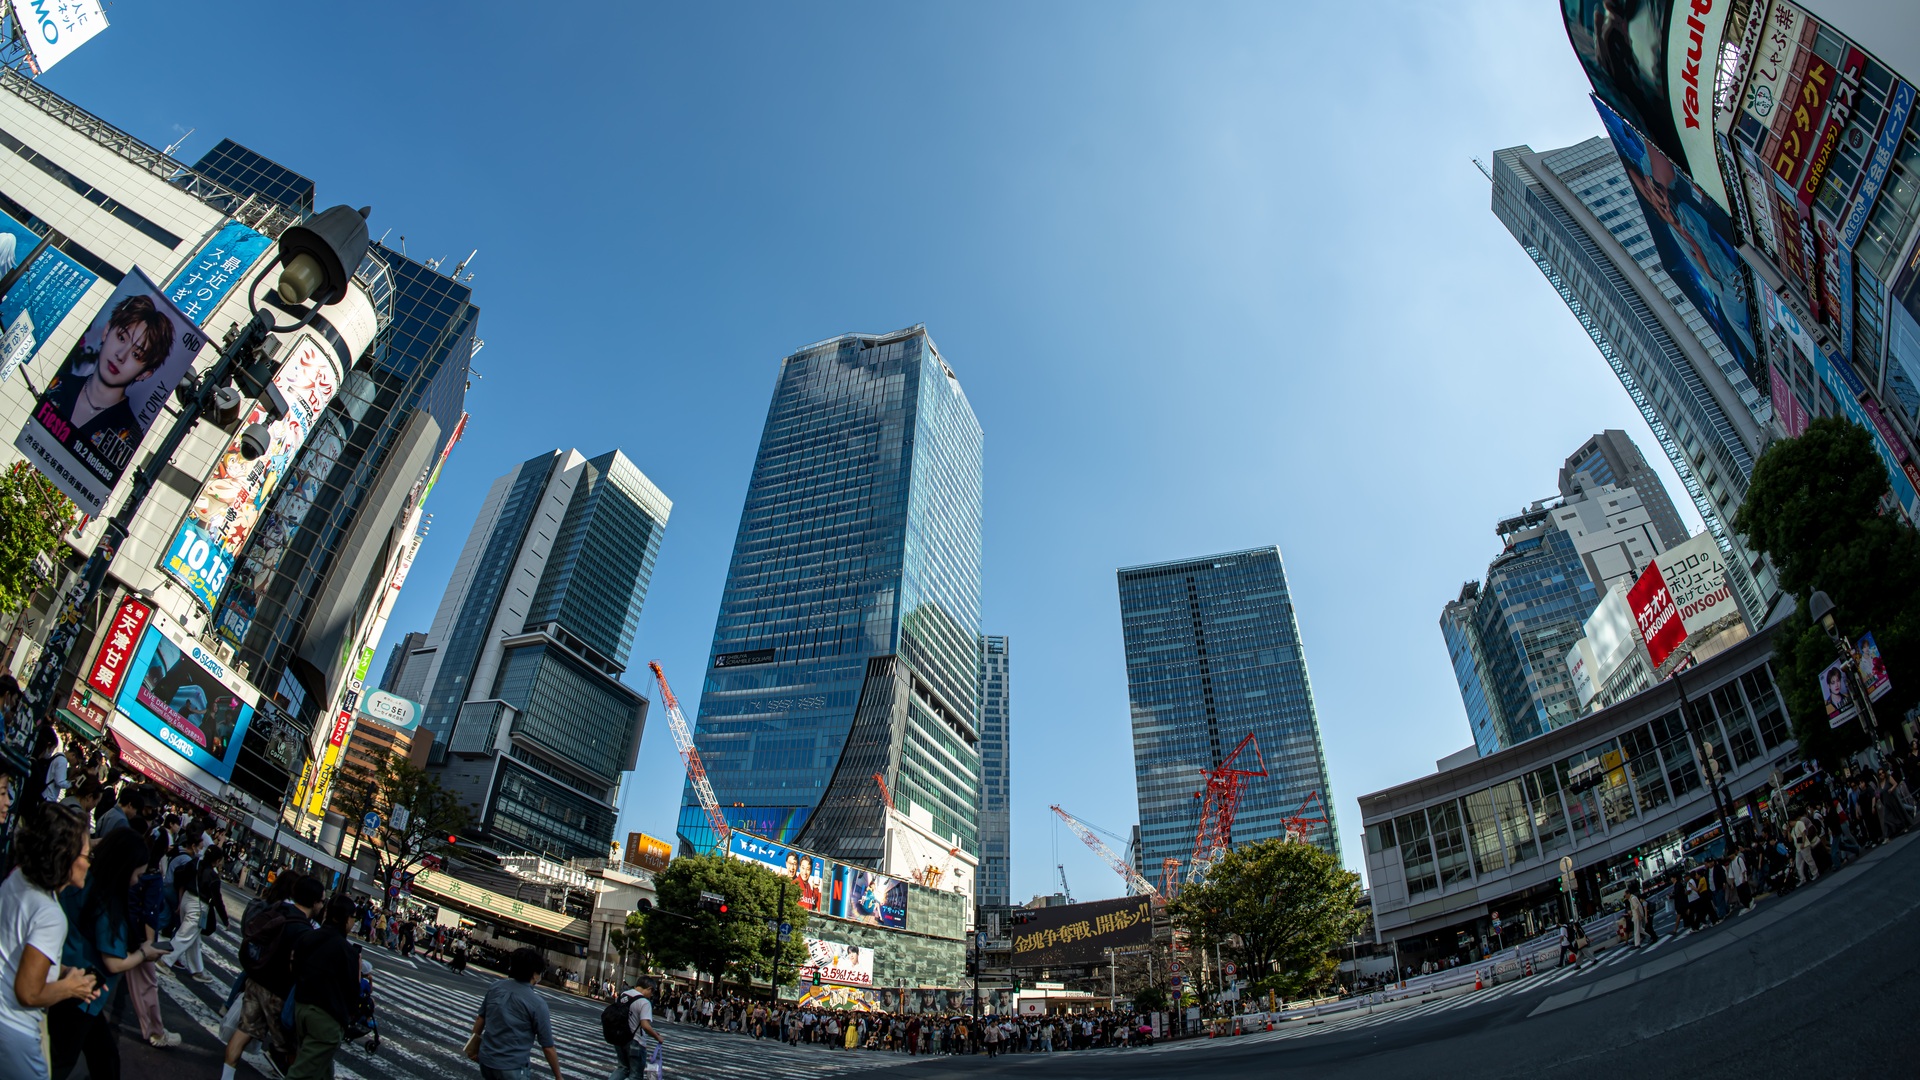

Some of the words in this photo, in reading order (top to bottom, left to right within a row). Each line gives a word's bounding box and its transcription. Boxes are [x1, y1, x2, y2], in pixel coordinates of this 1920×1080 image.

[1760, 3, 1794, 82] しゃぶ葉
[1681, 0, 1713, 130] Yakult
[1831, 65, 1862, 129] ガスト
[1775, 63, 1827, 181] コンタクト
[1846, 206, 1867, 242] AEON
[172, 247, 225, 303] スゴすぎ
[182, 255, 241, 320] 最近の主
[149, 381, 172, 415] ONLY
[37, 401, 71, 443] Fiesta
[73, 439, 88, 459] 10.2
[85, 453, 114, 481] Release
[177, 529, 228, 593] 10.13
[1662, 552, 1709, 581] ココロの
[1669, 560, 1724, 594] ボリューム
[125, 603, 144, 618] 名物
[1637, 587, 1667, 631] カラオケ
[1643, 602, 1676, 644] JOYSOUND
[1679, 585, 1732, 621] JOYSOUN
[95, 613, 138, 688] 天津甘栗
[200, 653, 223, 679] STARTS
[168, 732, 194, 757] STARTS
